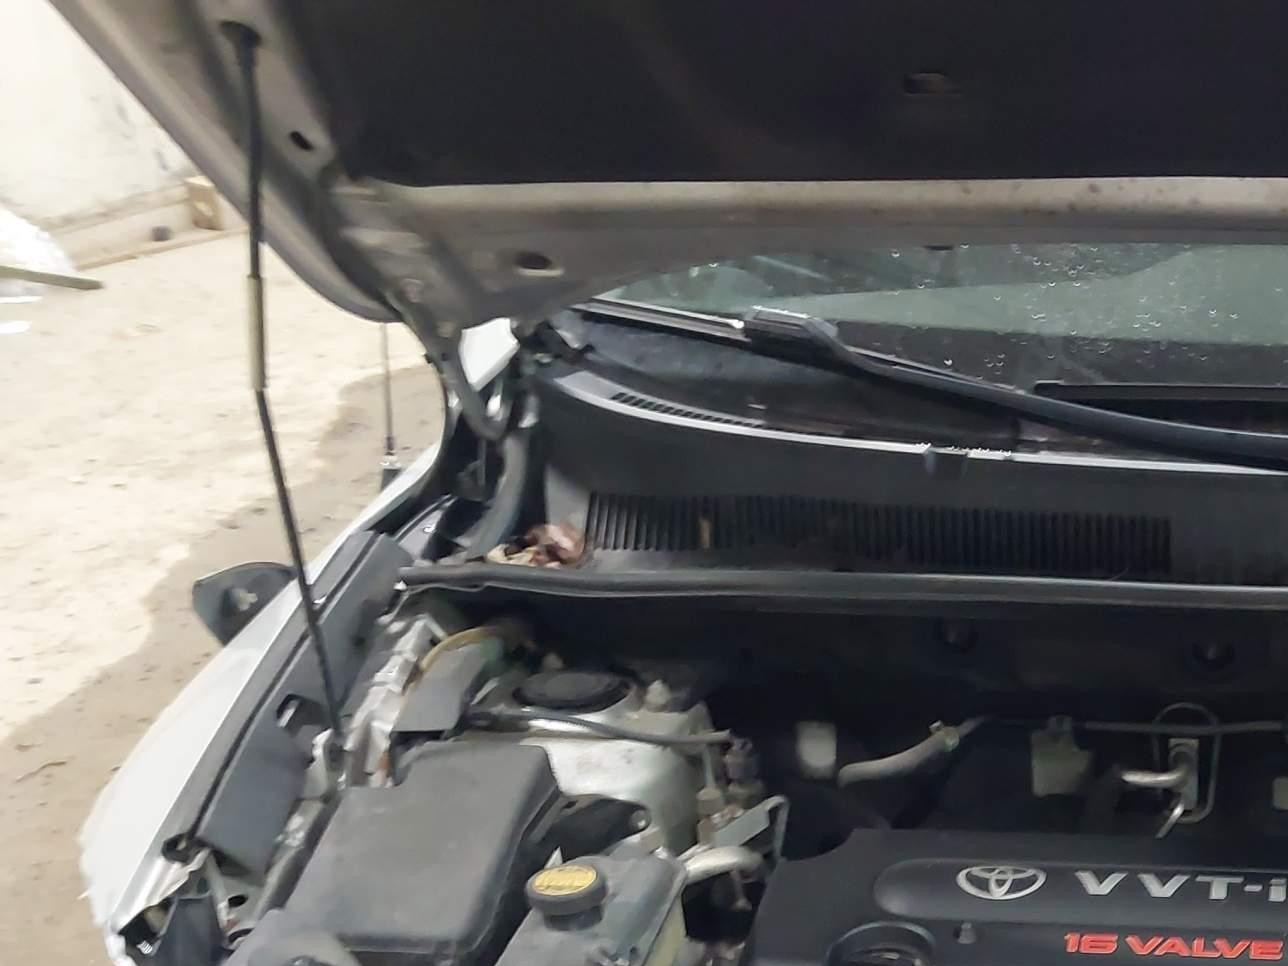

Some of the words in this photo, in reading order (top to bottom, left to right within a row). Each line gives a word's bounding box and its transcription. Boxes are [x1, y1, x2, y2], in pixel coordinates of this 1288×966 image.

[1074, 870, 1288, 903] VVT-i
[1063, 932, 1119, 954] 16
[1124, 934, 1284, 961] VALVE
